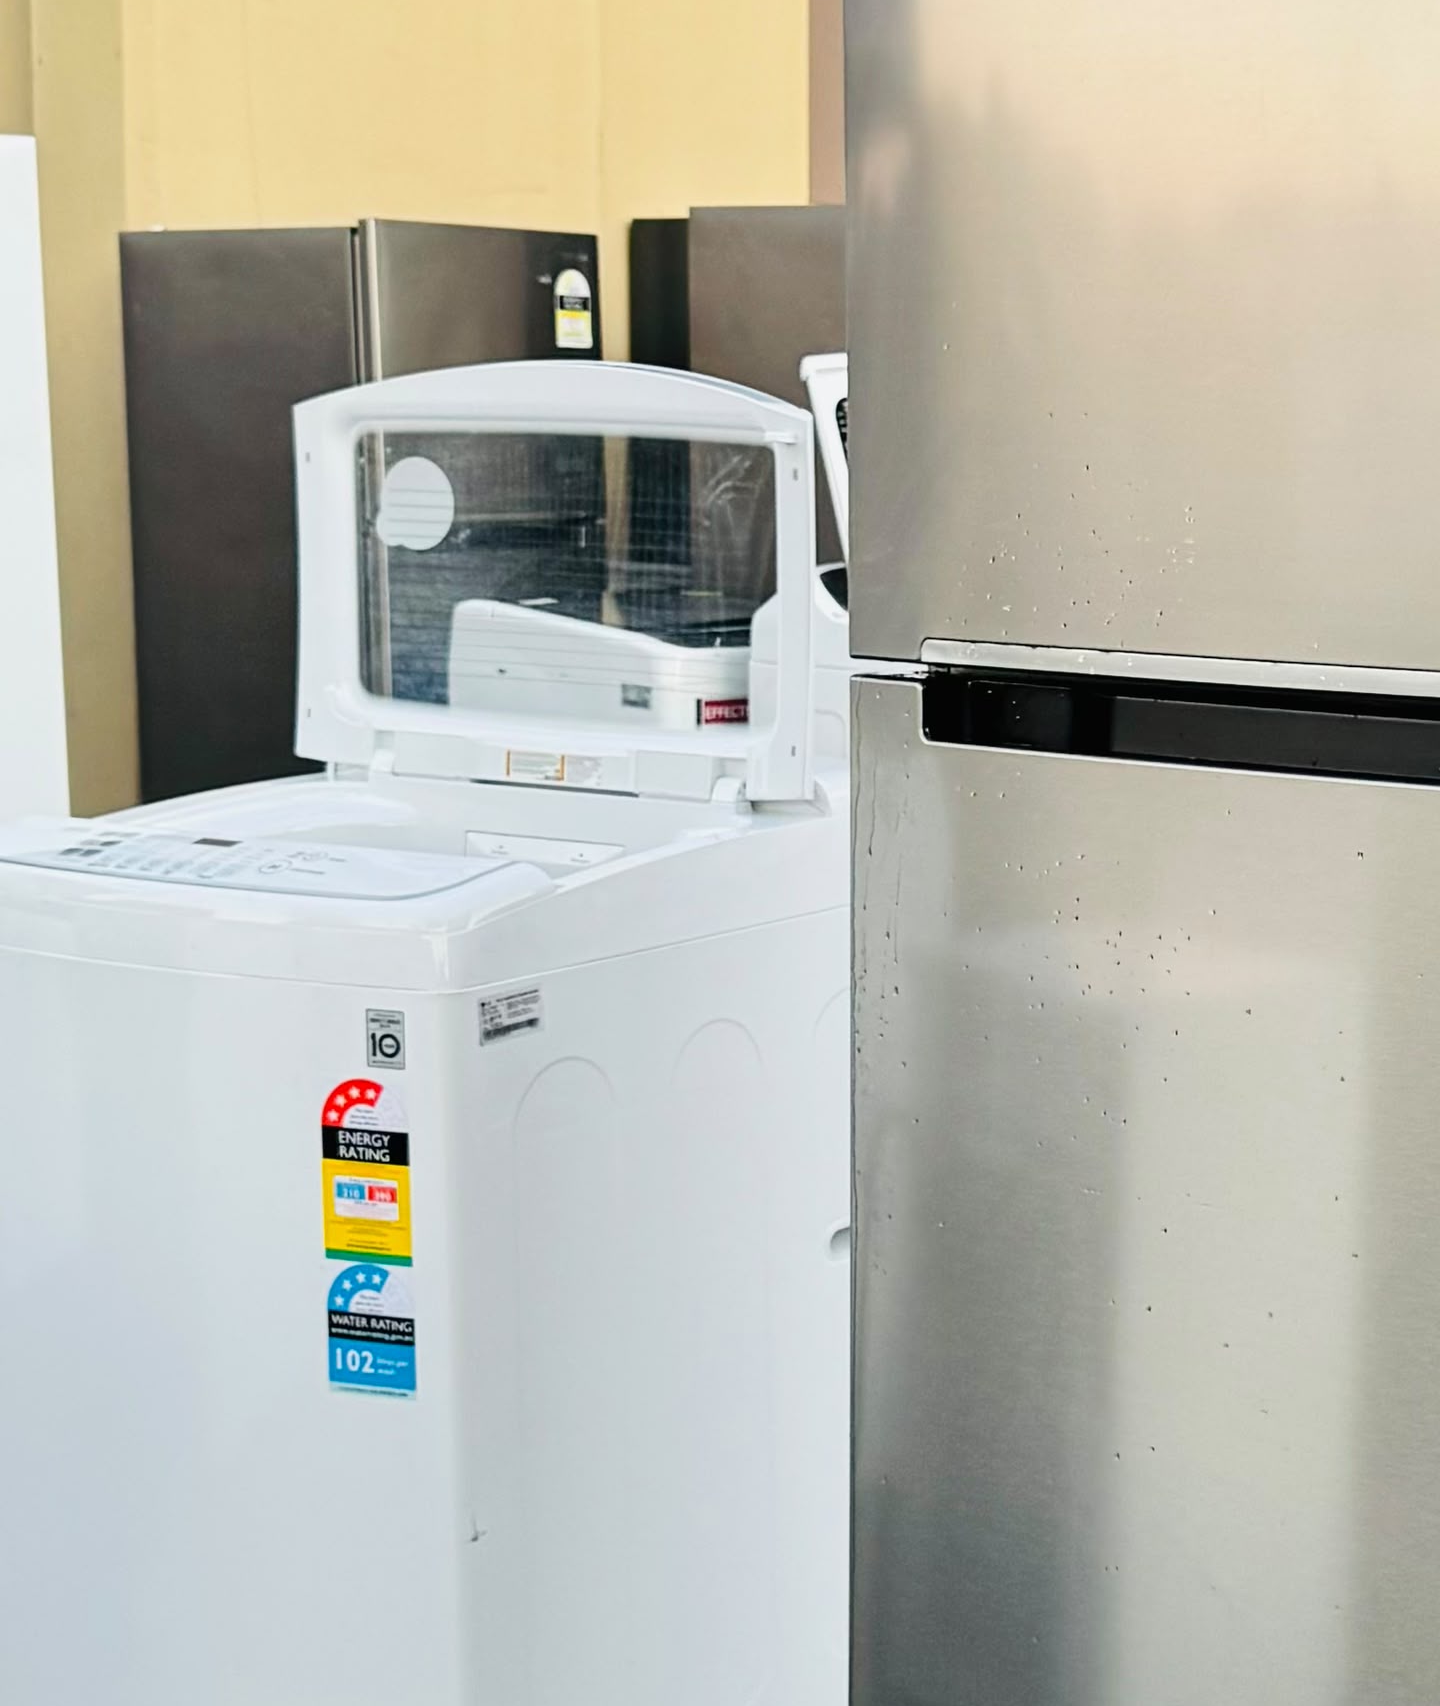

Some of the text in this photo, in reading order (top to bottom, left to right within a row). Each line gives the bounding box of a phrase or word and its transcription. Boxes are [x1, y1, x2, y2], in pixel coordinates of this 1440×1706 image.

[371, 1032, 401, 1059] 10
[338, 1130, 391, 1148] ENERGY
[339, 1145, 391, 1163] RATING
[331, 1313, 413, 1333] WATER RATING
[335, 1347, 375, 1374] 102
